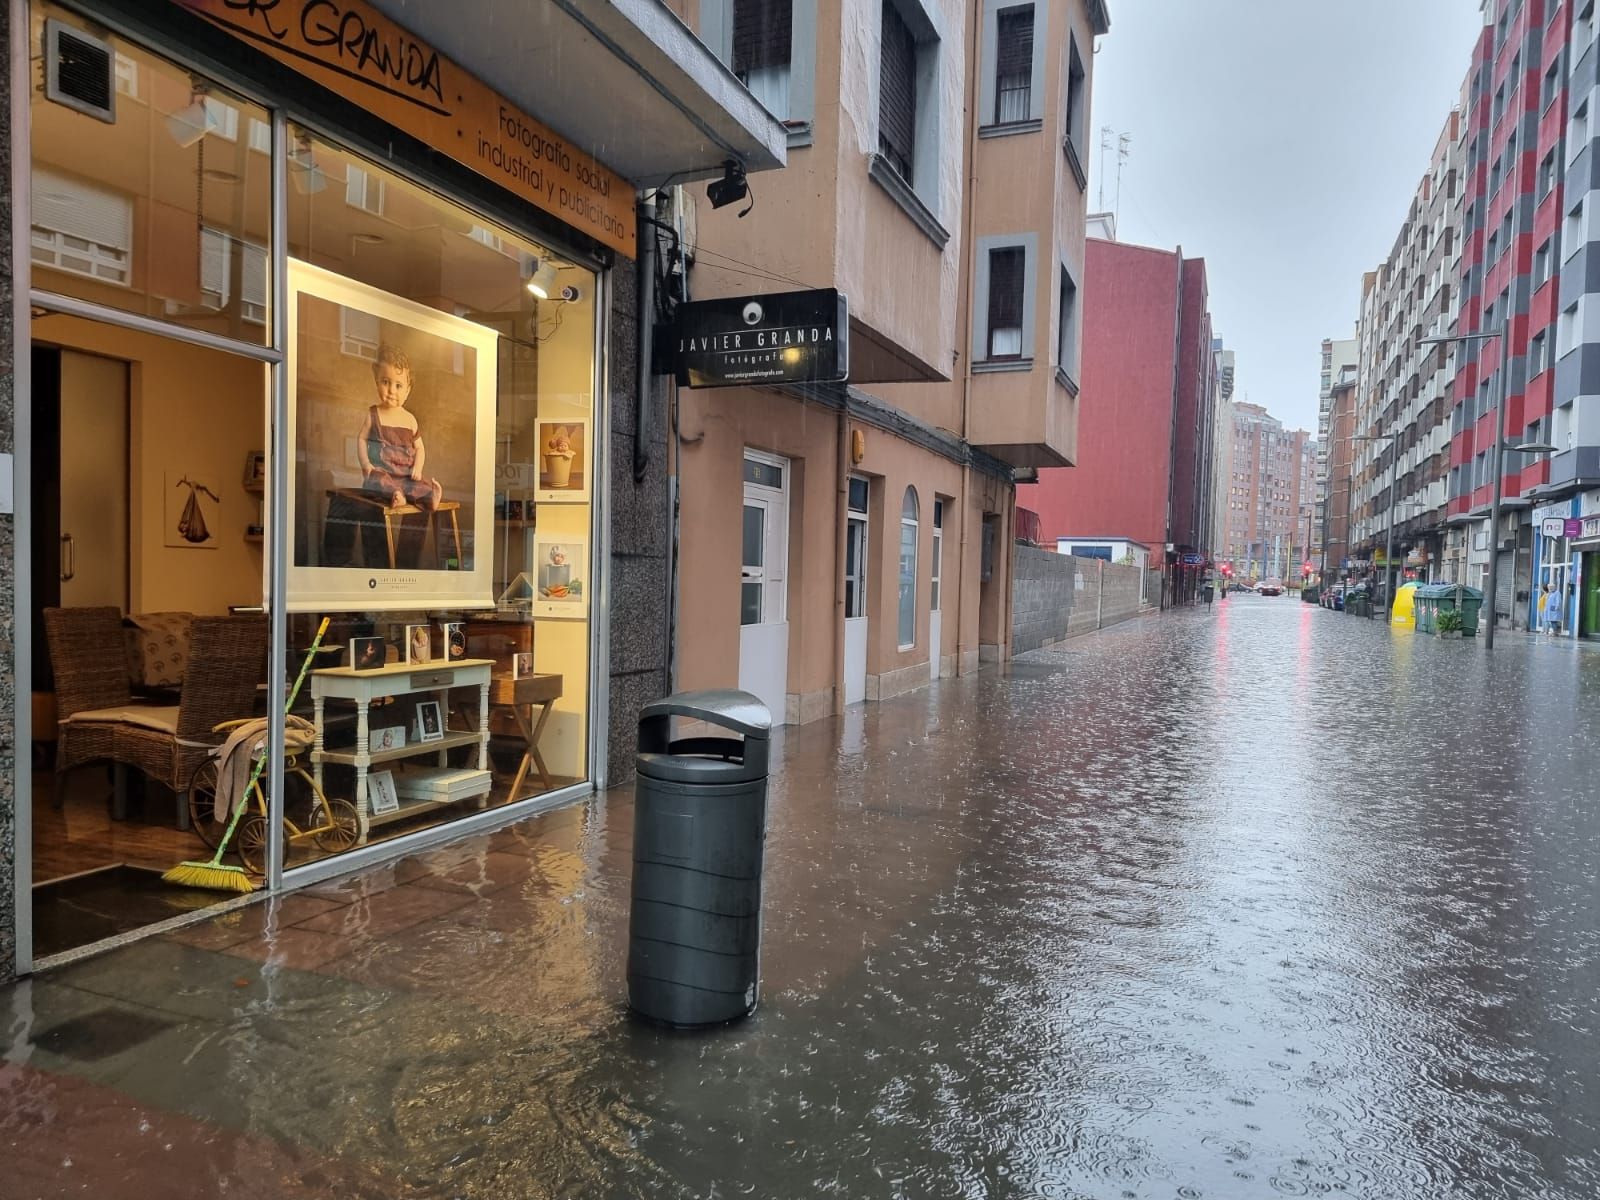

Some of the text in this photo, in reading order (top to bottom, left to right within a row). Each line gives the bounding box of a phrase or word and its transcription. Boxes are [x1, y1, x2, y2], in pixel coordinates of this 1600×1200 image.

[224, 0, 443, 104] R GRANDA
[478, 130, 625, 240] industrial y publicitaria
[500, 106, 610, 199] Fotografía social
[679, 326, 833, 353] JAVIER GRANDA
